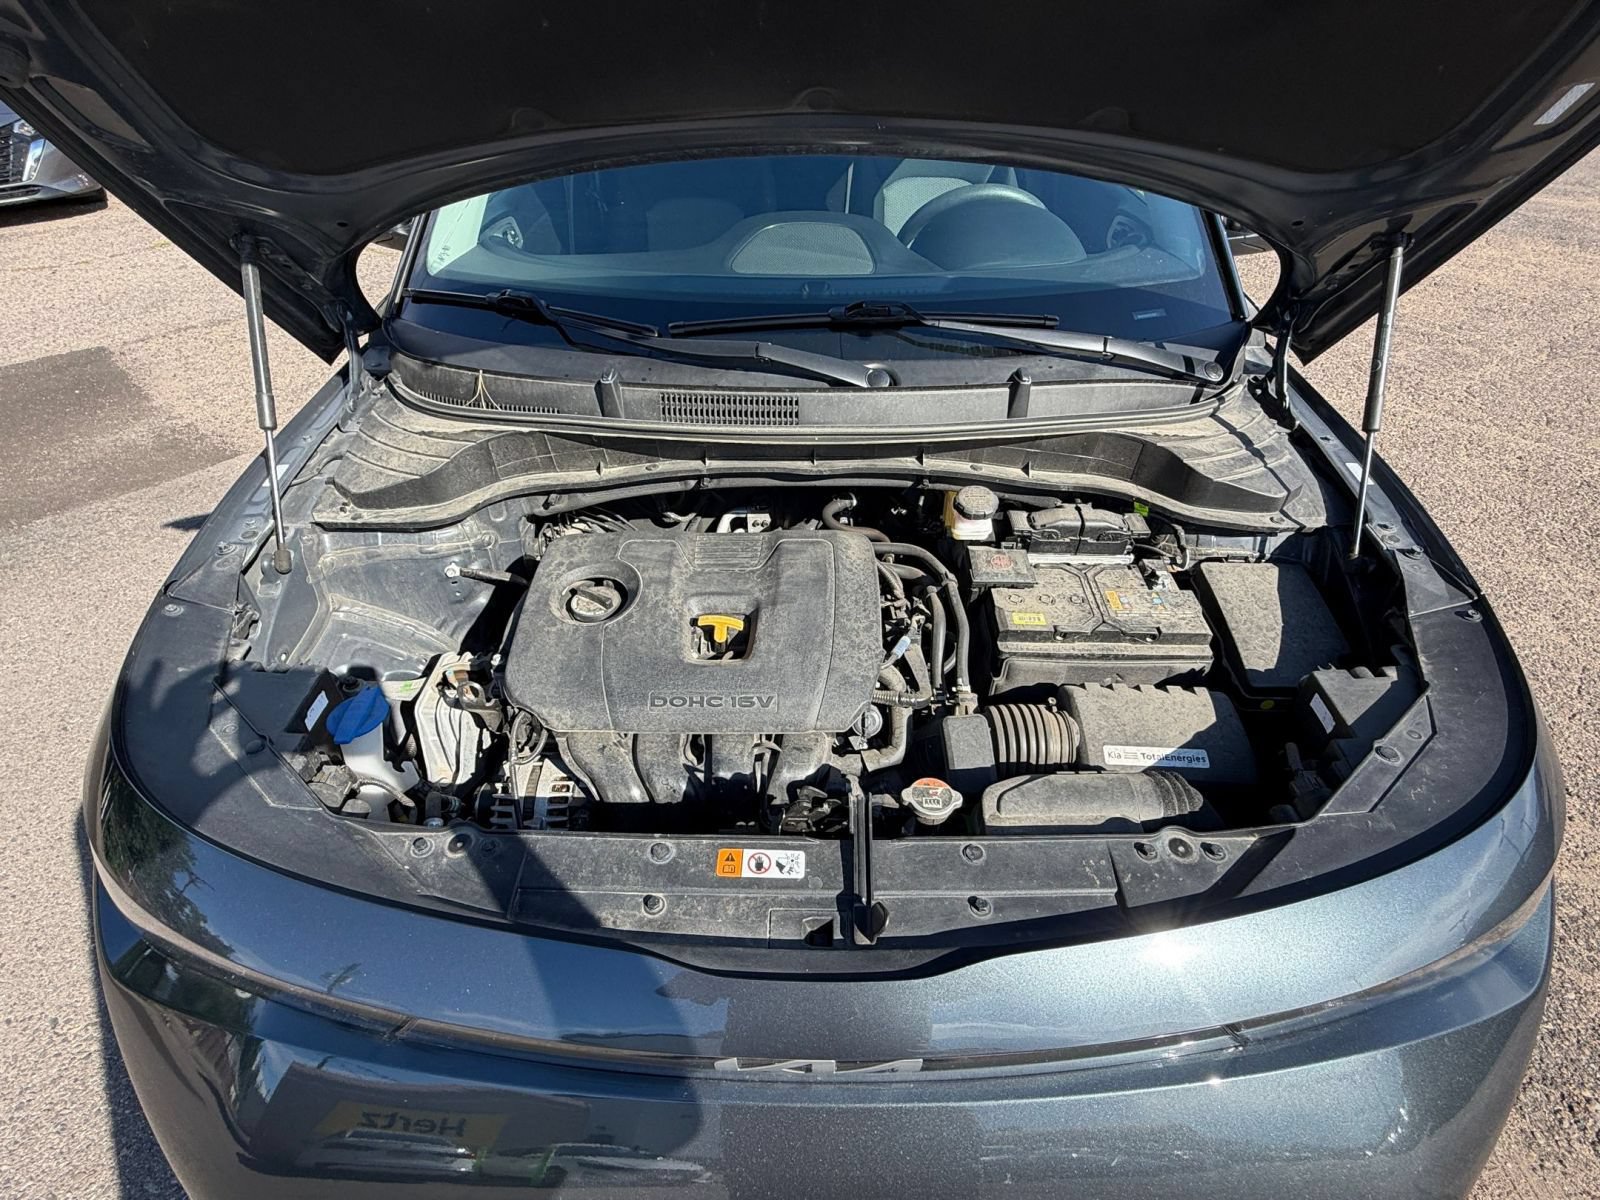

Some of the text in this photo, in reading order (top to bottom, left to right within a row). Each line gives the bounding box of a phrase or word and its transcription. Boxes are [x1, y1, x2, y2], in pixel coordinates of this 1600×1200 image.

[650, 696, 774, 709] DOHC 16V
[1107, 751, 1207, 764] Kia TotalEnergies
